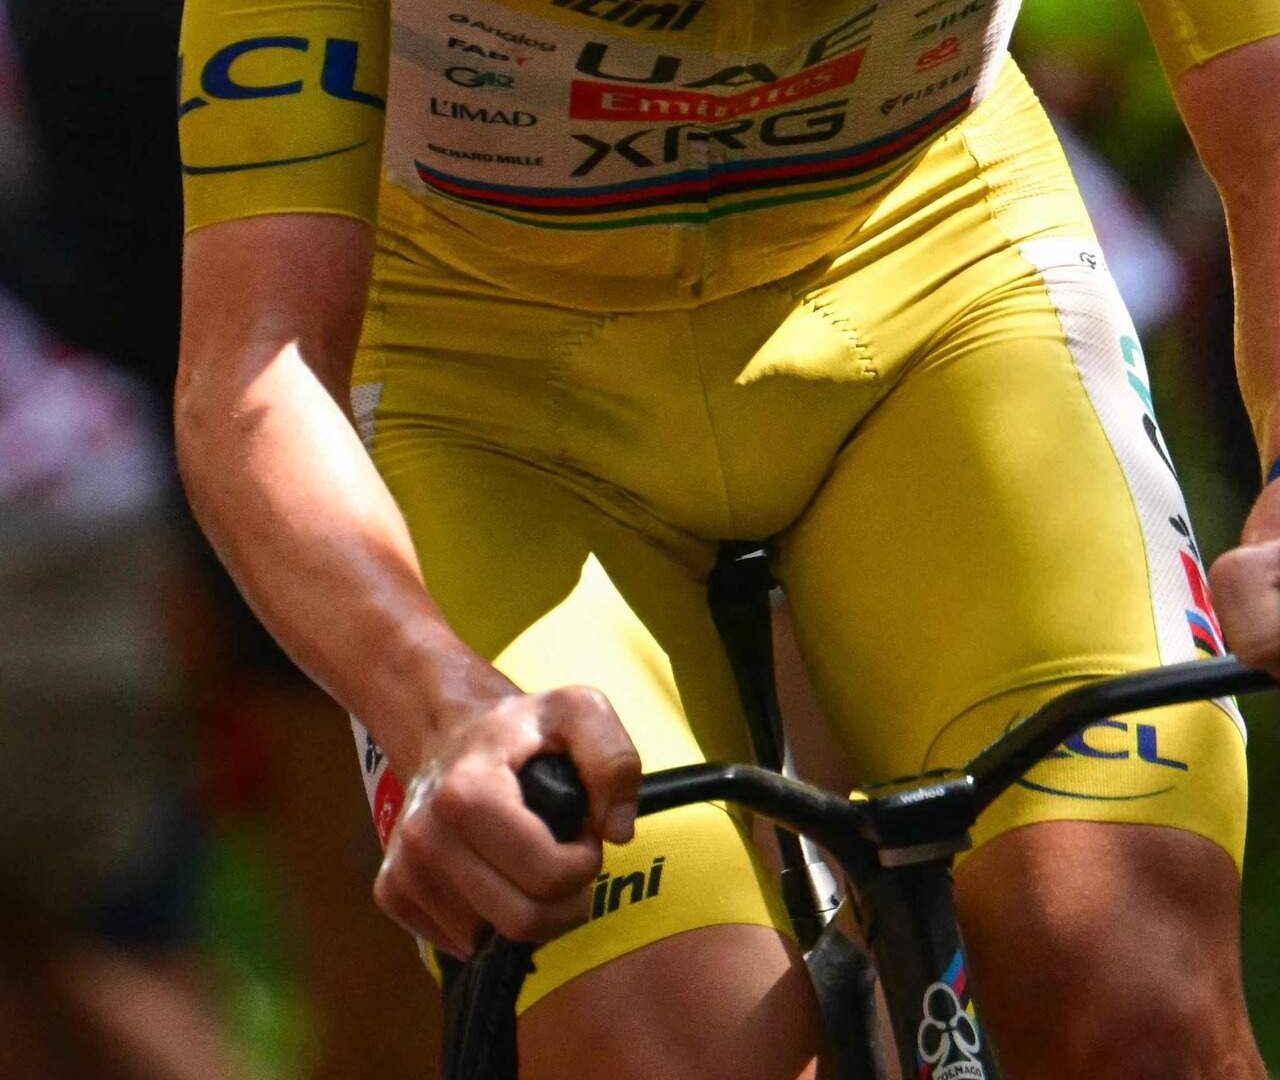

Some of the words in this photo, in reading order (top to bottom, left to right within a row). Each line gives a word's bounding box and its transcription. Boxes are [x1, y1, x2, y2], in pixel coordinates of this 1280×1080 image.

[575, 4, 877, 88] UAE
[430, 97, 538, 127] L'IMAD
[569, 98, 849, 177] XRG
[1042, 719, 1188, 771] CL
